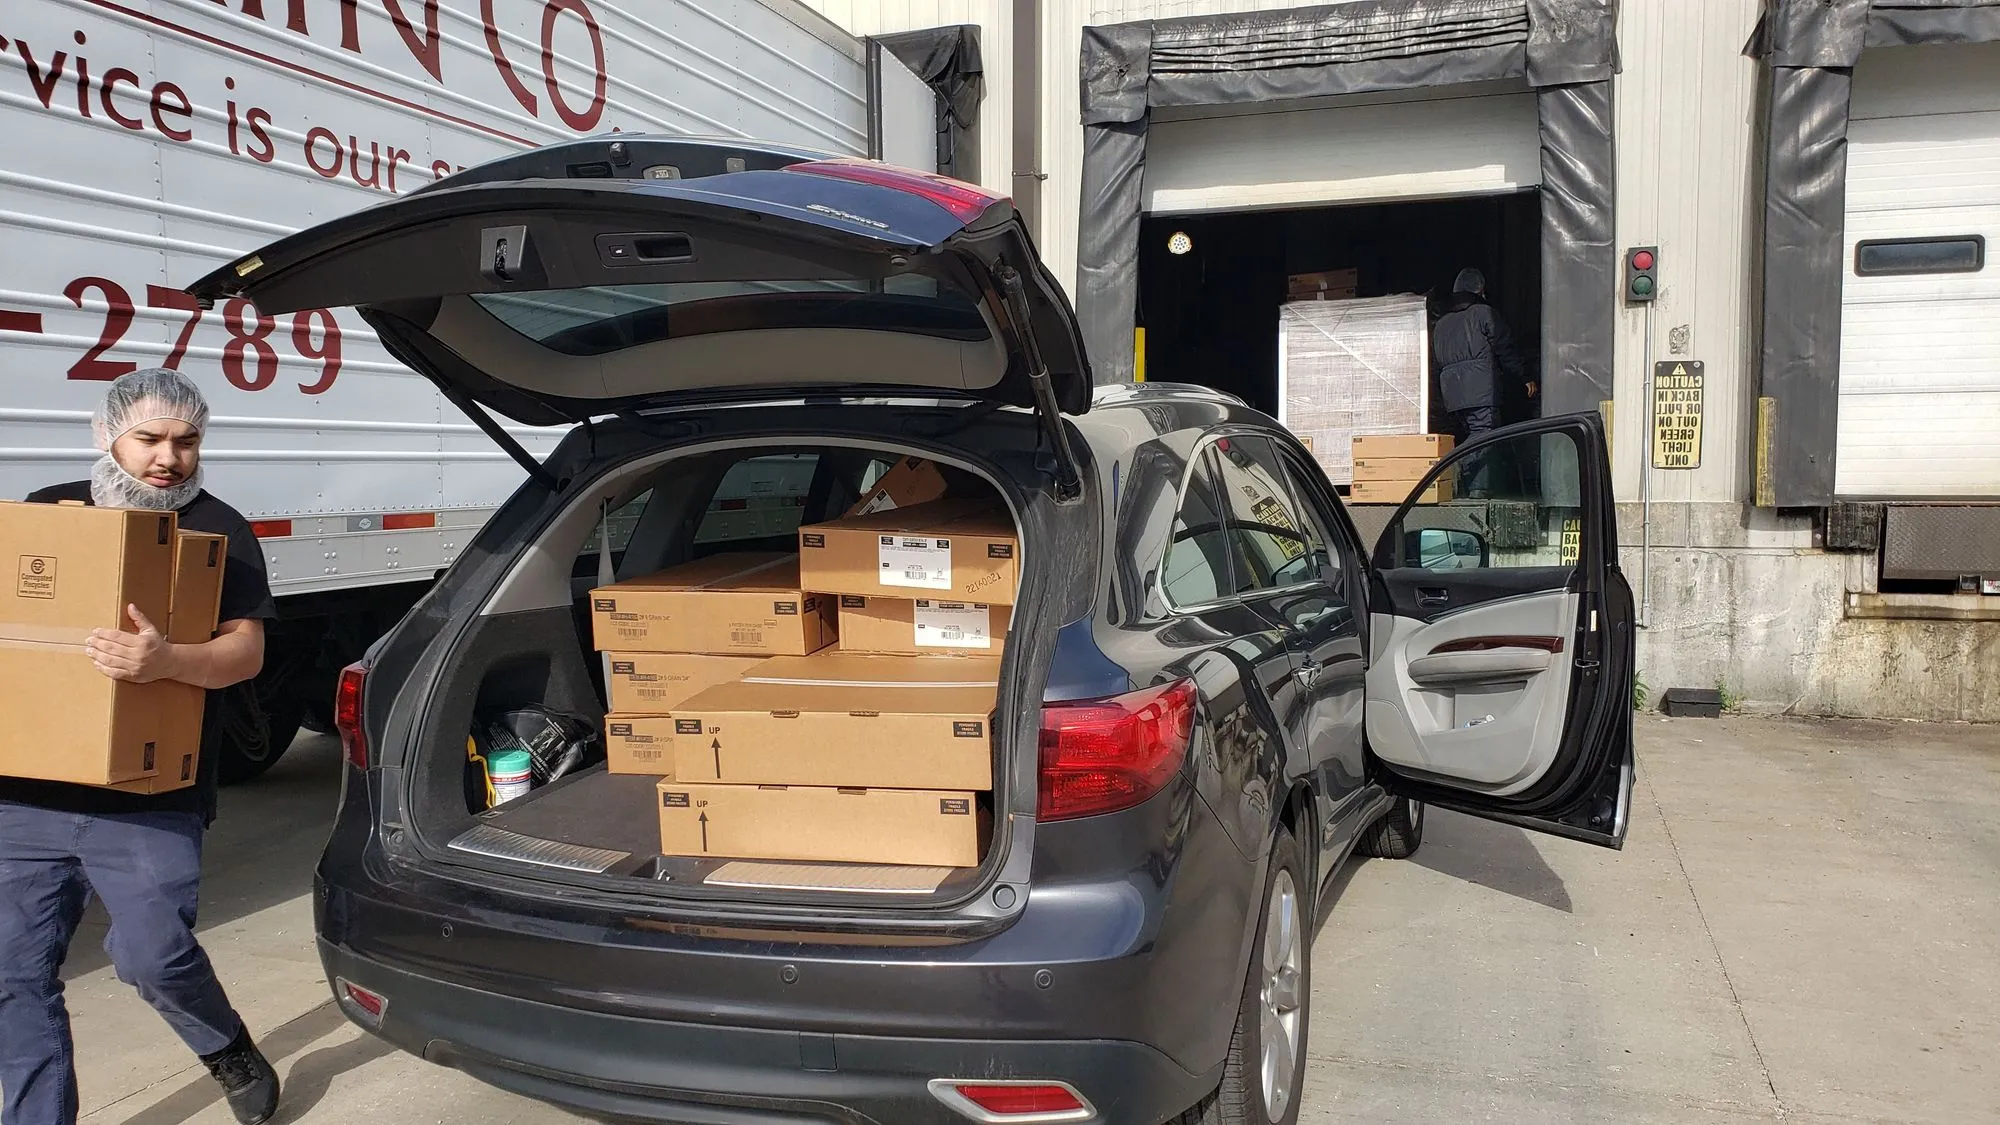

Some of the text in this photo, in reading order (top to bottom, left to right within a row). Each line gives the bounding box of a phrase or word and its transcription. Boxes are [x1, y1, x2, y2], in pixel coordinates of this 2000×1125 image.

[0, 30, 193, 141] vice
[225, 76, 274, 162] is
[303, 126, 411, 193] our
[1565, 533, 1580, 545] BA
[1563, 546, 1576, 557] OR
[708, 726, 720, 735] UP
[696, 800, 708, 808] UP
